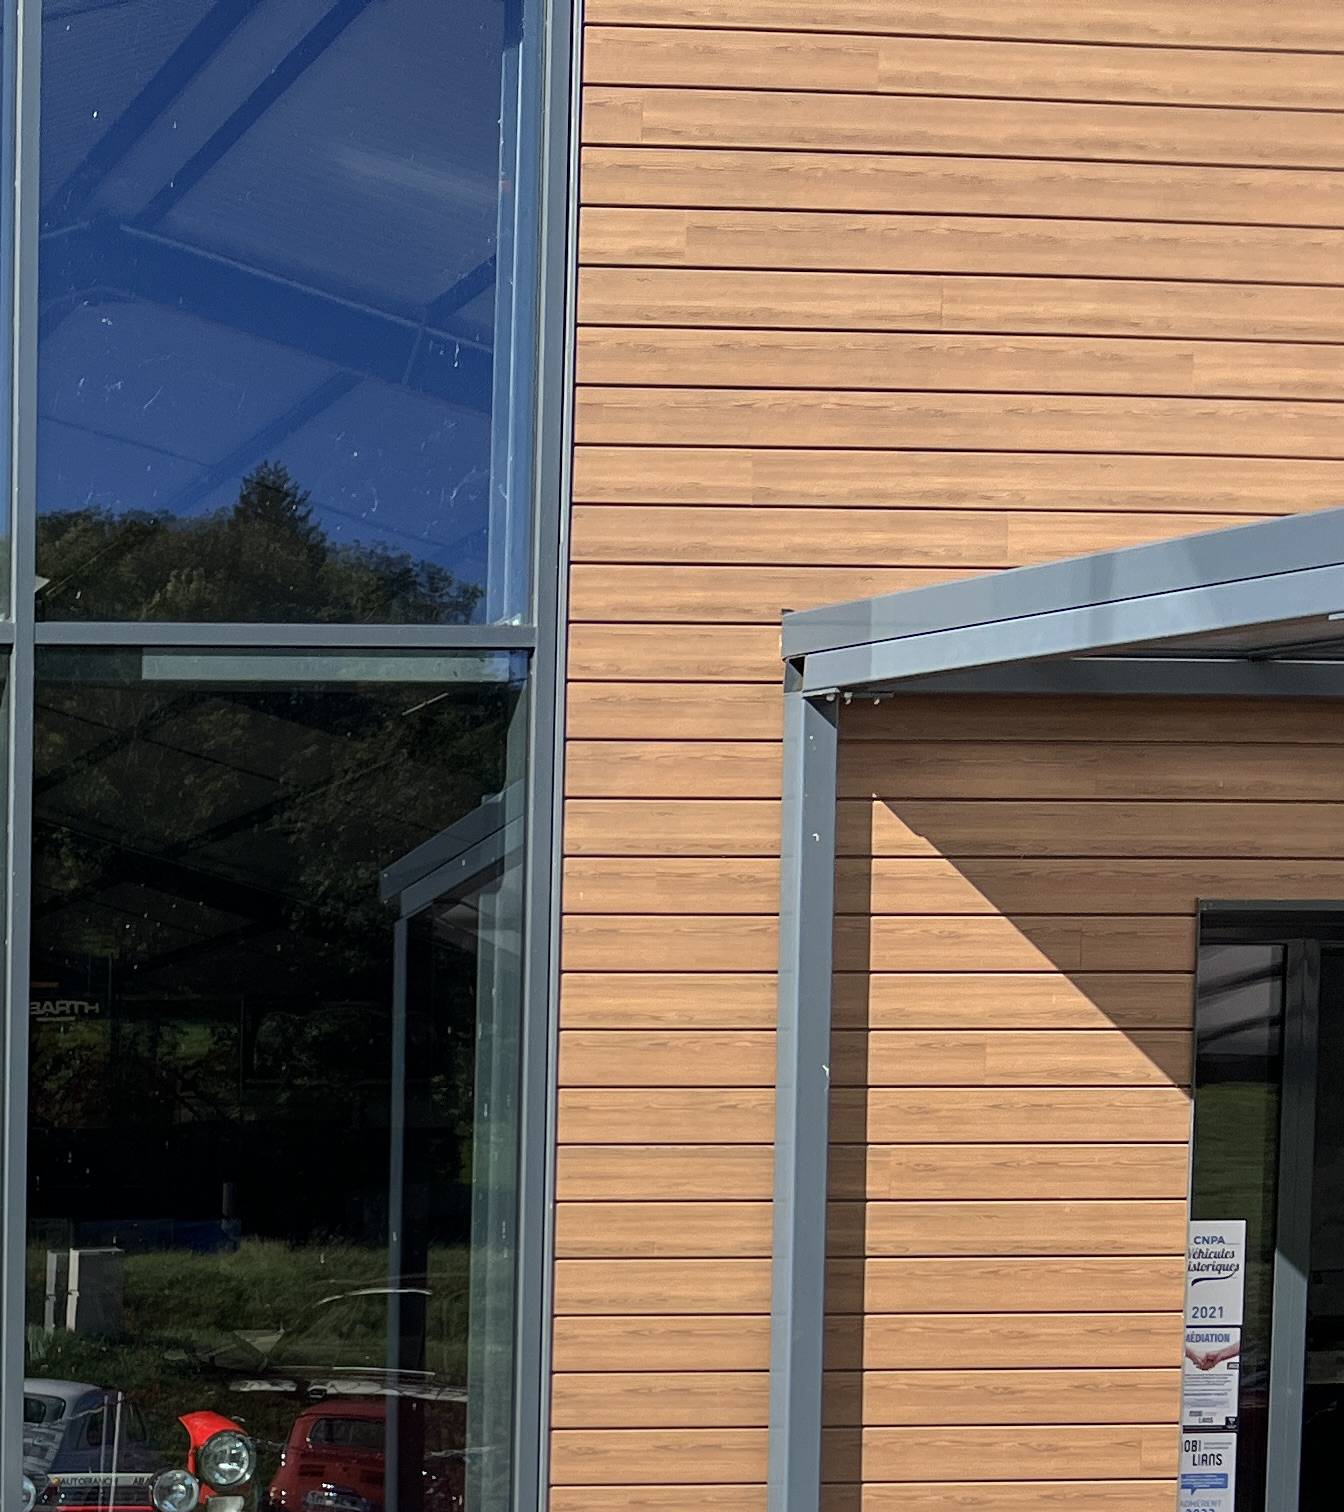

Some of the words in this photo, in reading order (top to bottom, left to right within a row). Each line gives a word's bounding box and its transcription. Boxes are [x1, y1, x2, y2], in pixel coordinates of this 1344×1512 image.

[1194, 1236, 1225, 1244] CNPA
[1188, 1261, 1239, 1274] istoriques
[1192, 1306, 1224, 1318] 2021
